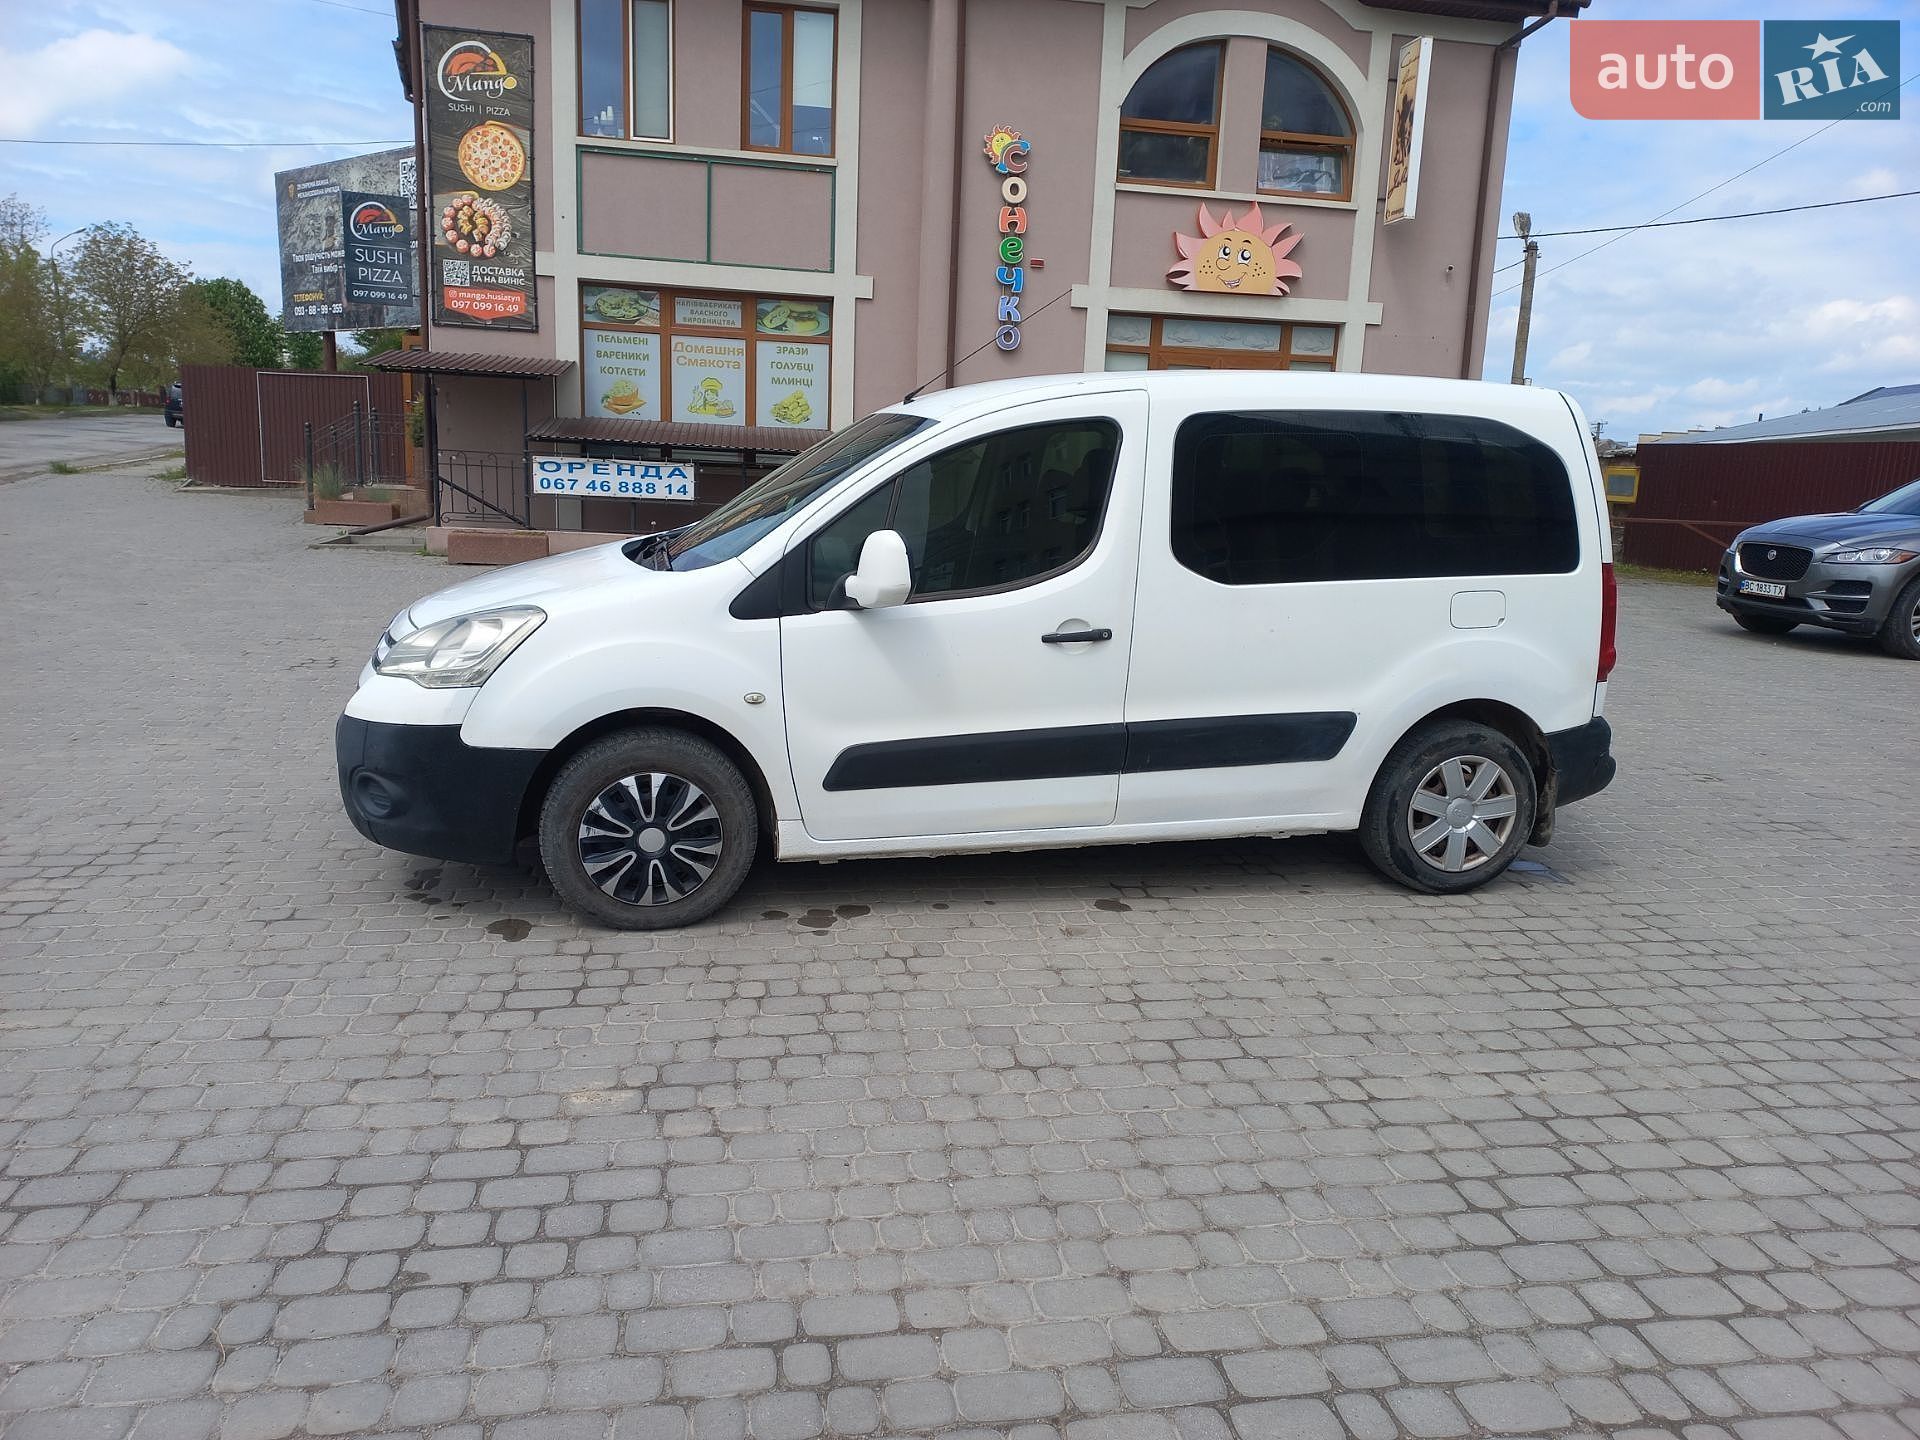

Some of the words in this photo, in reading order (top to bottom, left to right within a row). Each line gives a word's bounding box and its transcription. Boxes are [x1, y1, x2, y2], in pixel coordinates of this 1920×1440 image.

[448, 75, 517, 98] Mango
[448, 102, 475, 114] SUSHI
[486, 106, 511, 117] PIZZA
[357, 223, 404, 239] Mango
[995, 140, 1029, 351] Сонечко
[355, 248, 403, 265] SUSHI
[358, 267, 403, 283] PIZZA
[472, 266, 525, 277] ДОСТАВКА
[472, 275, 483, 283] ТА
[484, 276, 497, 284] НА
[498, 277, 526, 286] ВИНІС
[353, 289, 369, 298] 097
[370, 290, 386, 299] 099
[388, 292, 396, 300] 16
[397, 293, 408, 301] 49
[451, 300, 471, 309] 097
[473, 301, 493, 311] 099
[494, 303, 504, 312] 16
[506, 304, 519, 313] 49
[690, 308, 728, 318] ВЛАСНОГО
[597, 334, 648, 346] ПЕЛЬМЕНІ
[596, 350, 650, 362] ВАРЕНИКИ
[672, 341, 744, 357] Домашня
[776, 345, 809, 356] ЗРАЗИ
[676, 355, 742, 370] Смакота
[771, 361, 814, 373] ГОЛУБЦІ
[600, 366, 647, 377] КОТЛЕТИ
[771, 376, 813, 388] МЛИНЦІ
[540, 460, 688, 481] ОРЕНДА
[540, 477, 578, 490] 067
[586, 479, 612, 493] 46
[618, 482, 657, 495] 888
[665, 484, 689, 496] 14
[1745, 581, 1755, 591] BC
[1773, 585, 1784, 596] TX
